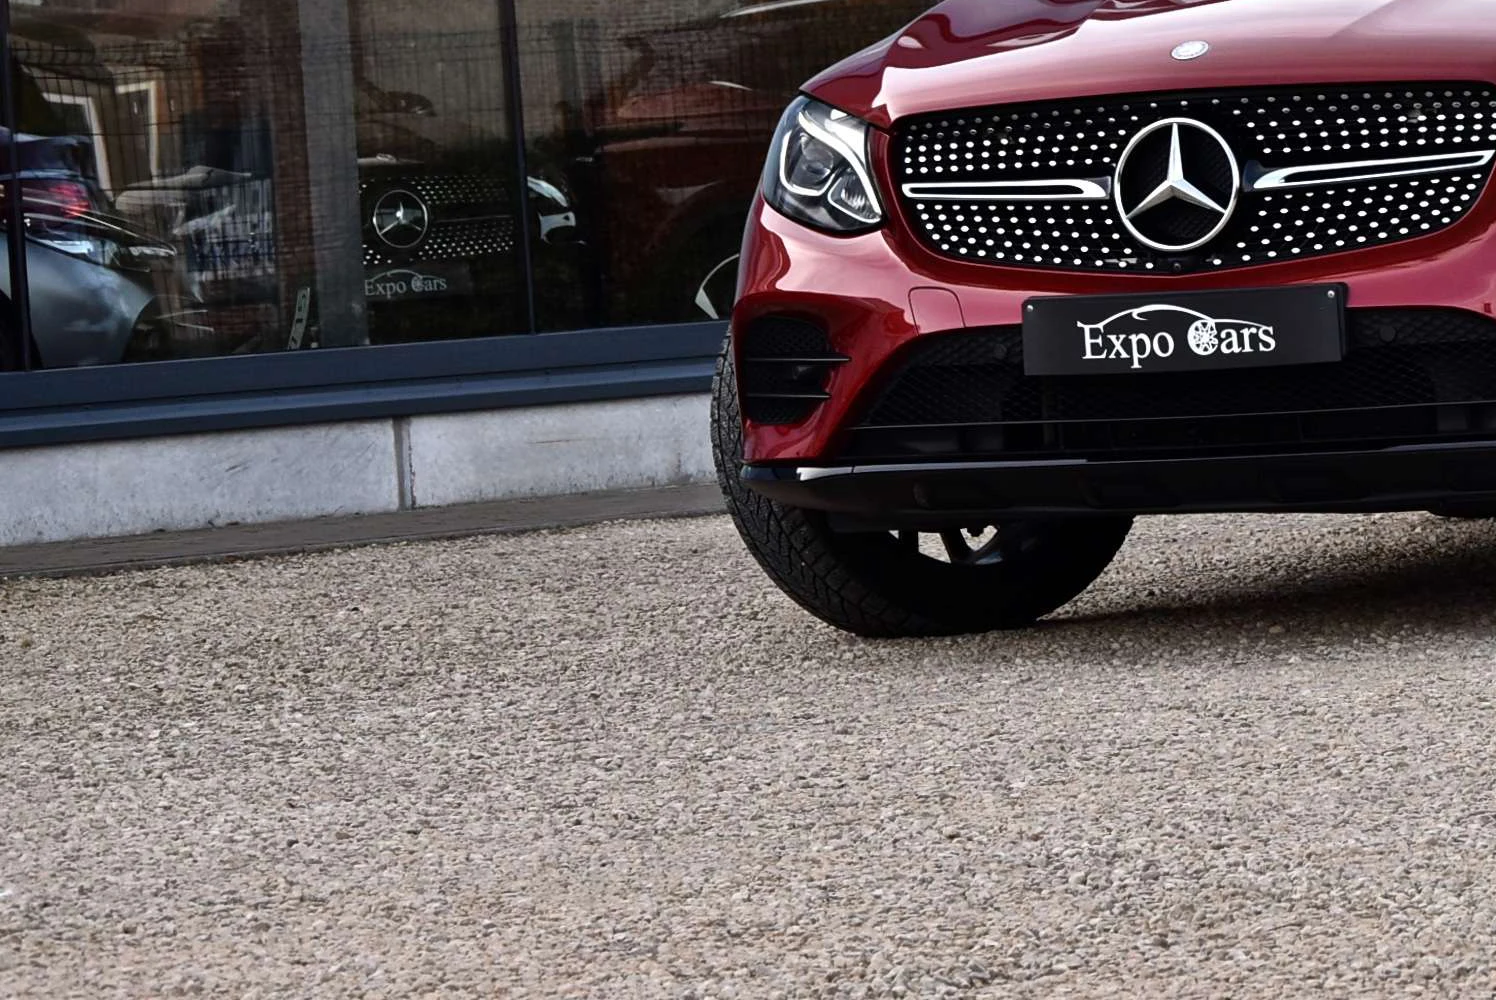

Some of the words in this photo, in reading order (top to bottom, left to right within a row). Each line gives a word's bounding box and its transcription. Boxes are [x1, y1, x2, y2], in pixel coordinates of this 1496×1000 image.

[364, 279, 407, 299] Expo
[411, 276, 448, 292] Cars
[1077, 321, 1175, 369] Expo
[1187, 319, 1276, 356] Cars
